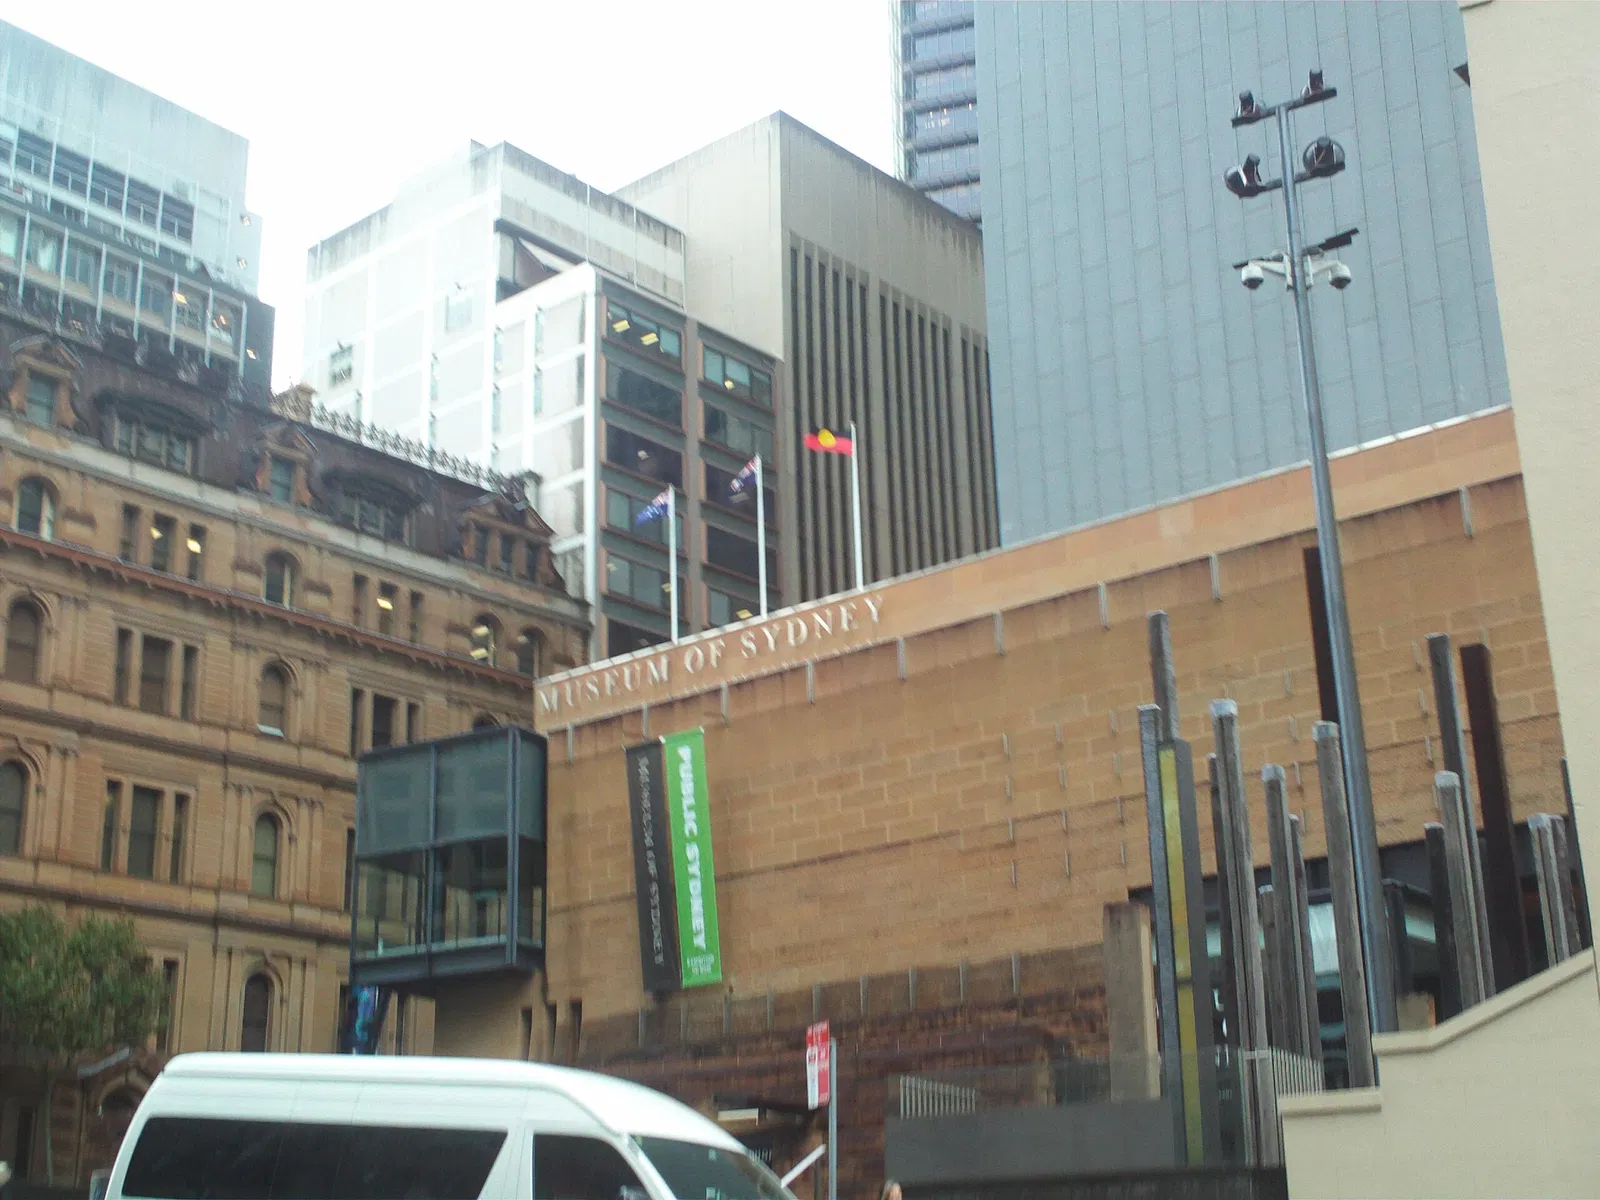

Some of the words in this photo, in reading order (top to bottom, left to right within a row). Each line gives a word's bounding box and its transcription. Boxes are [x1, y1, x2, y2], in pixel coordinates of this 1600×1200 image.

[538, 655, 669, 713] MUSEUM
[684, 638, 726, 673] OF
[740, 594, 884, 660] SYDNEY
[677, 745, 698, 838] PUBLIC
[685, 841, 706, 950] SYDNEY
